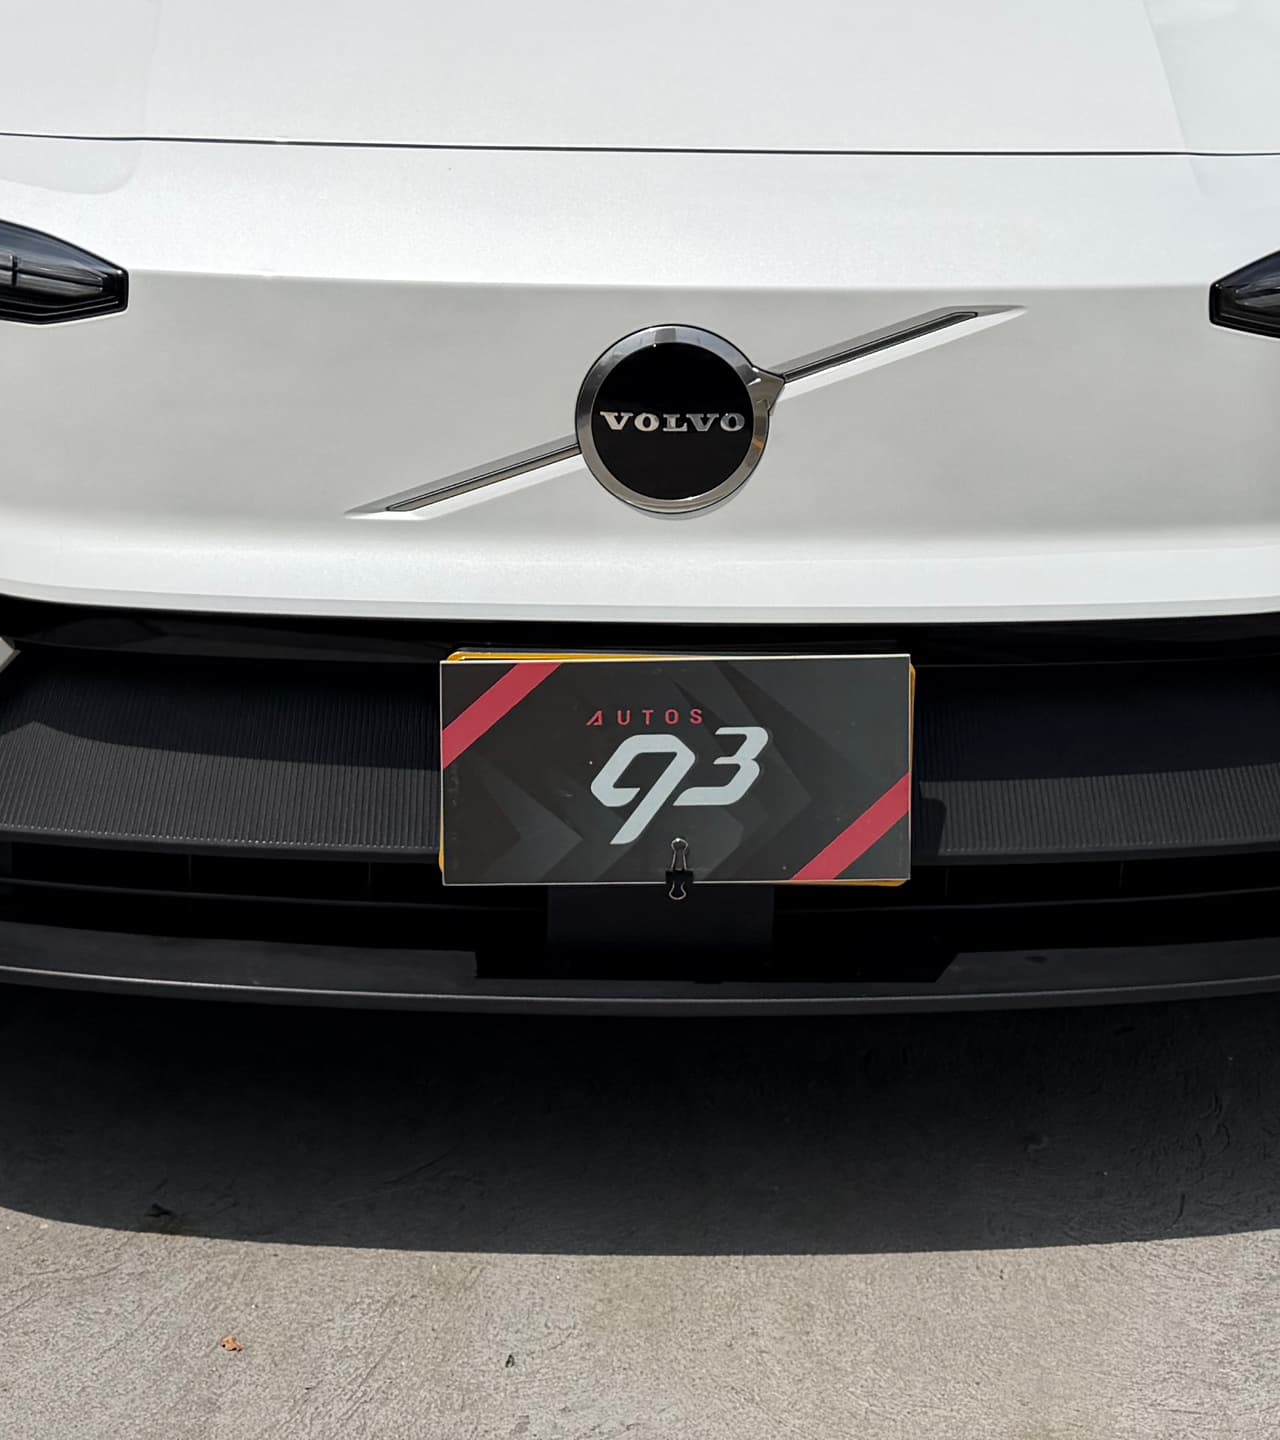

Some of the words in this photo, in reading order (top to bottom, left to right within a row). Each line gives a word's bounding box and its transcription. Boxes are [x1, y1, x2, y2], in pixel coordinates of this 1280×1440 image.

[599, 411, 746, 433] VOLVO
[586, 707, 704, 727] AUTOS
[590, 726, 769, 845] 93
